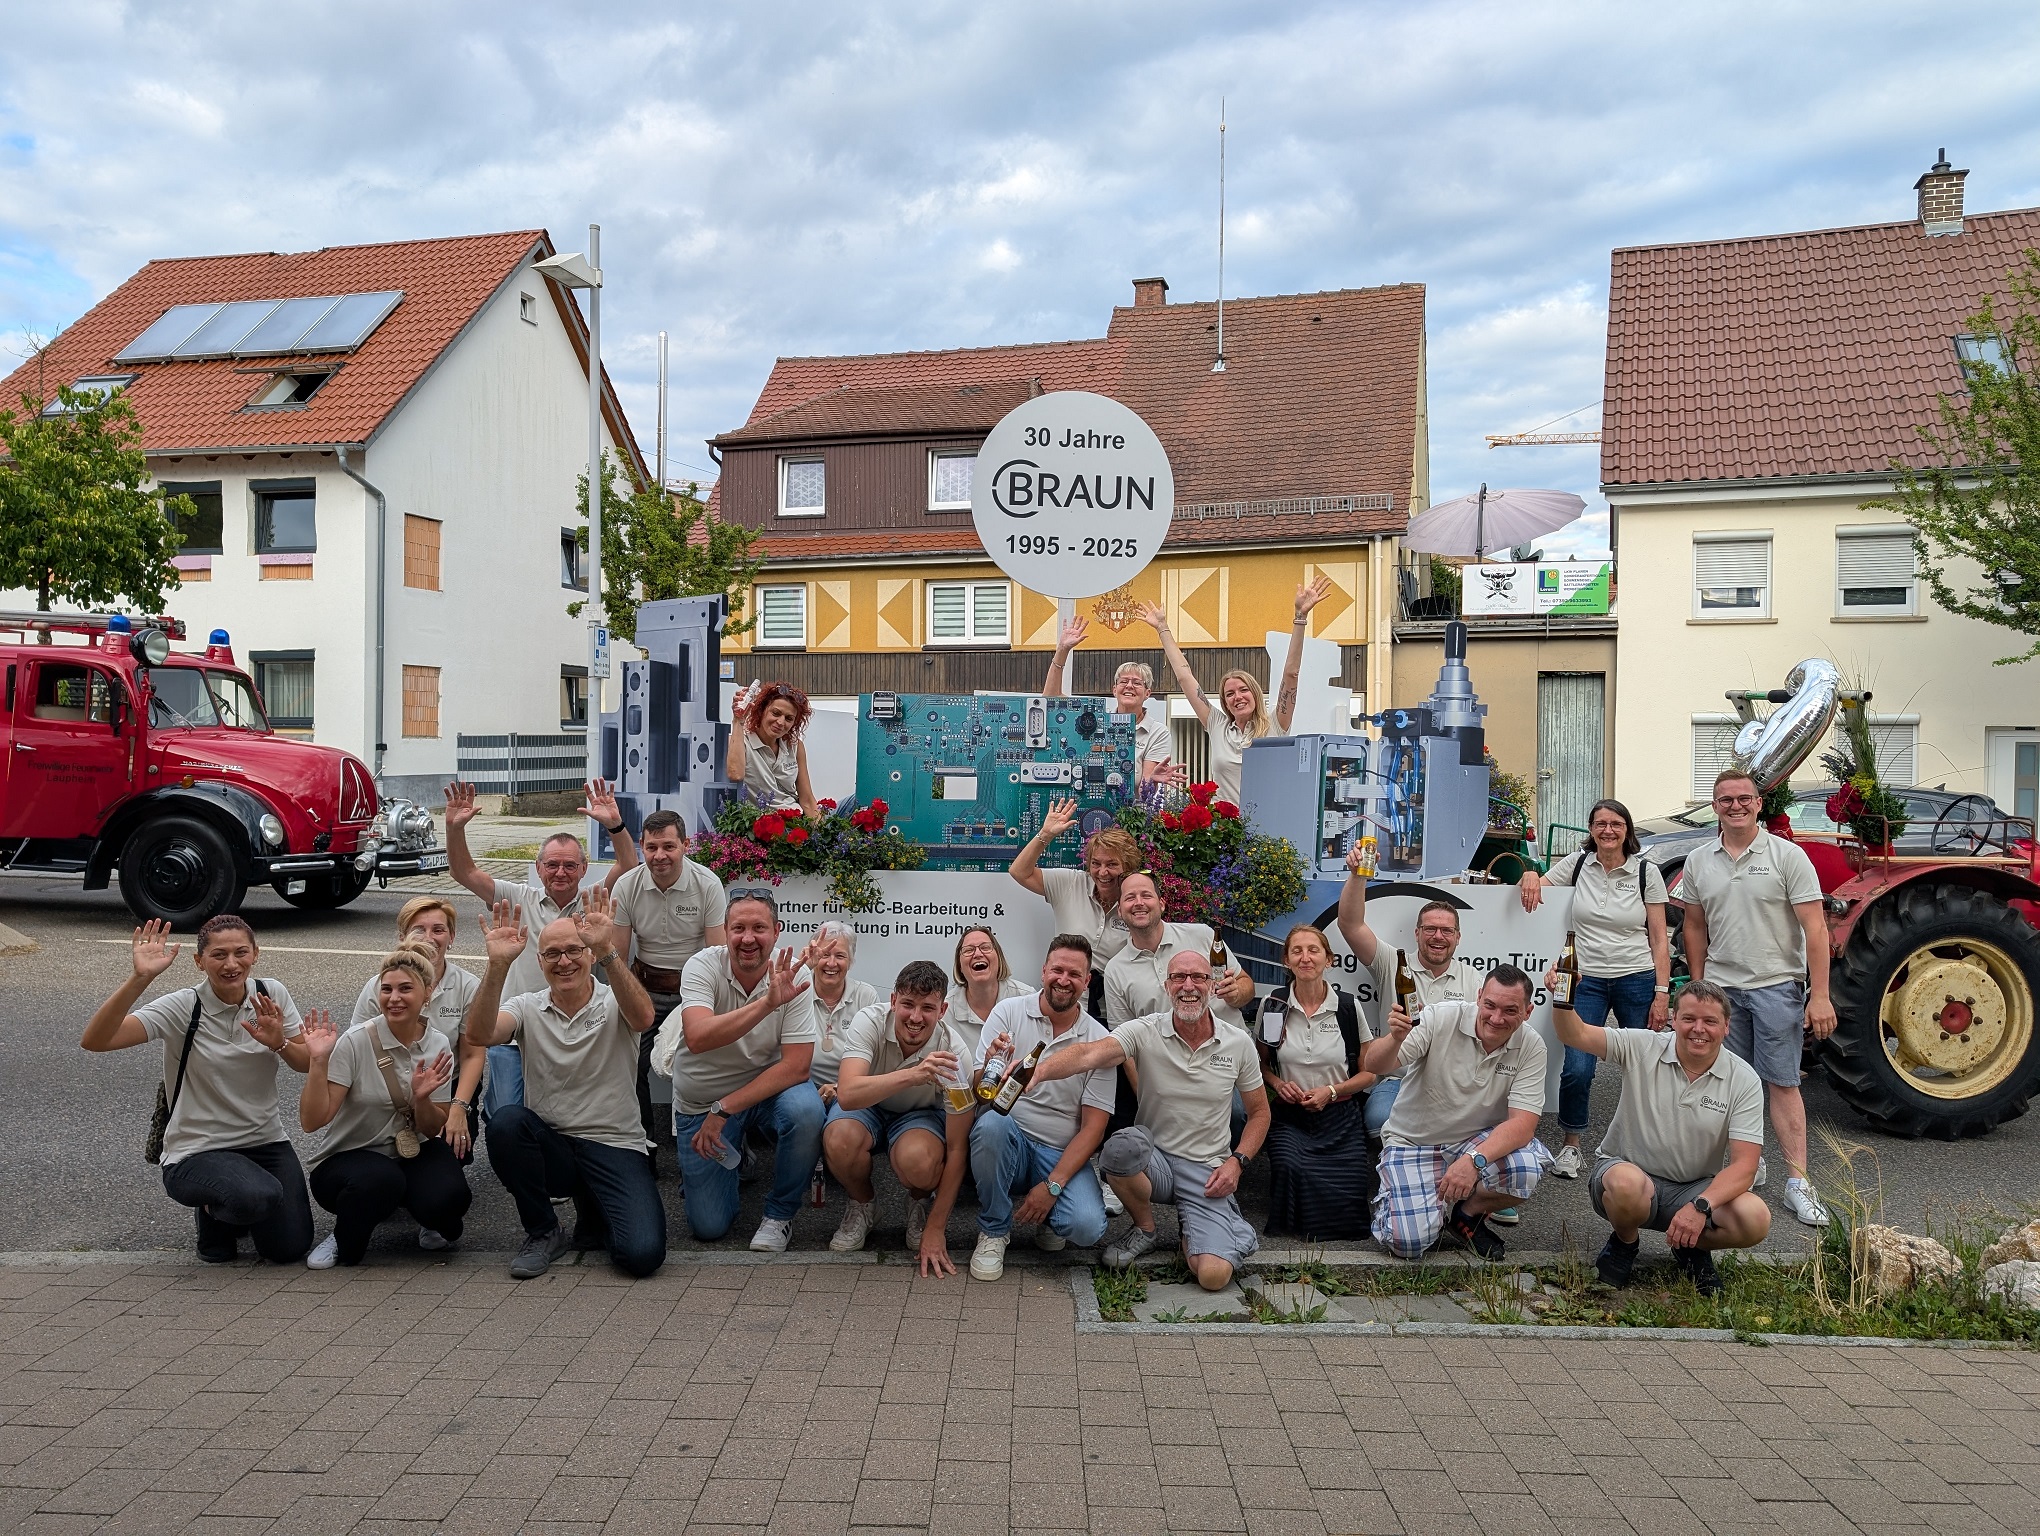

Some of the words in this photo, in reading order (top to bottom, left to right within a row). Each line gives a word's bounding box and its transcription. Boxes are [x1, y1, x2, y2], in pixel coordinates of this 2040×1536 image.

[1024, 427, 1050, 447] 30
[1058, 428, 1125, 450] Jahre
[1000, 463, 1155, 515] BRAUN
[1005, 534, 1060, 555] 1995
[1082, 537, 1138, 558] 2025
[28, 760, 70, 771] Freiwillige
[47, 774, 96, 784] Laupheim
[993, 903, 1005, 916] &
[895, 921, 909, 934] in
[1330, 953, 1358, 973] ag
[1508, 952, 1549, 972] Tür
